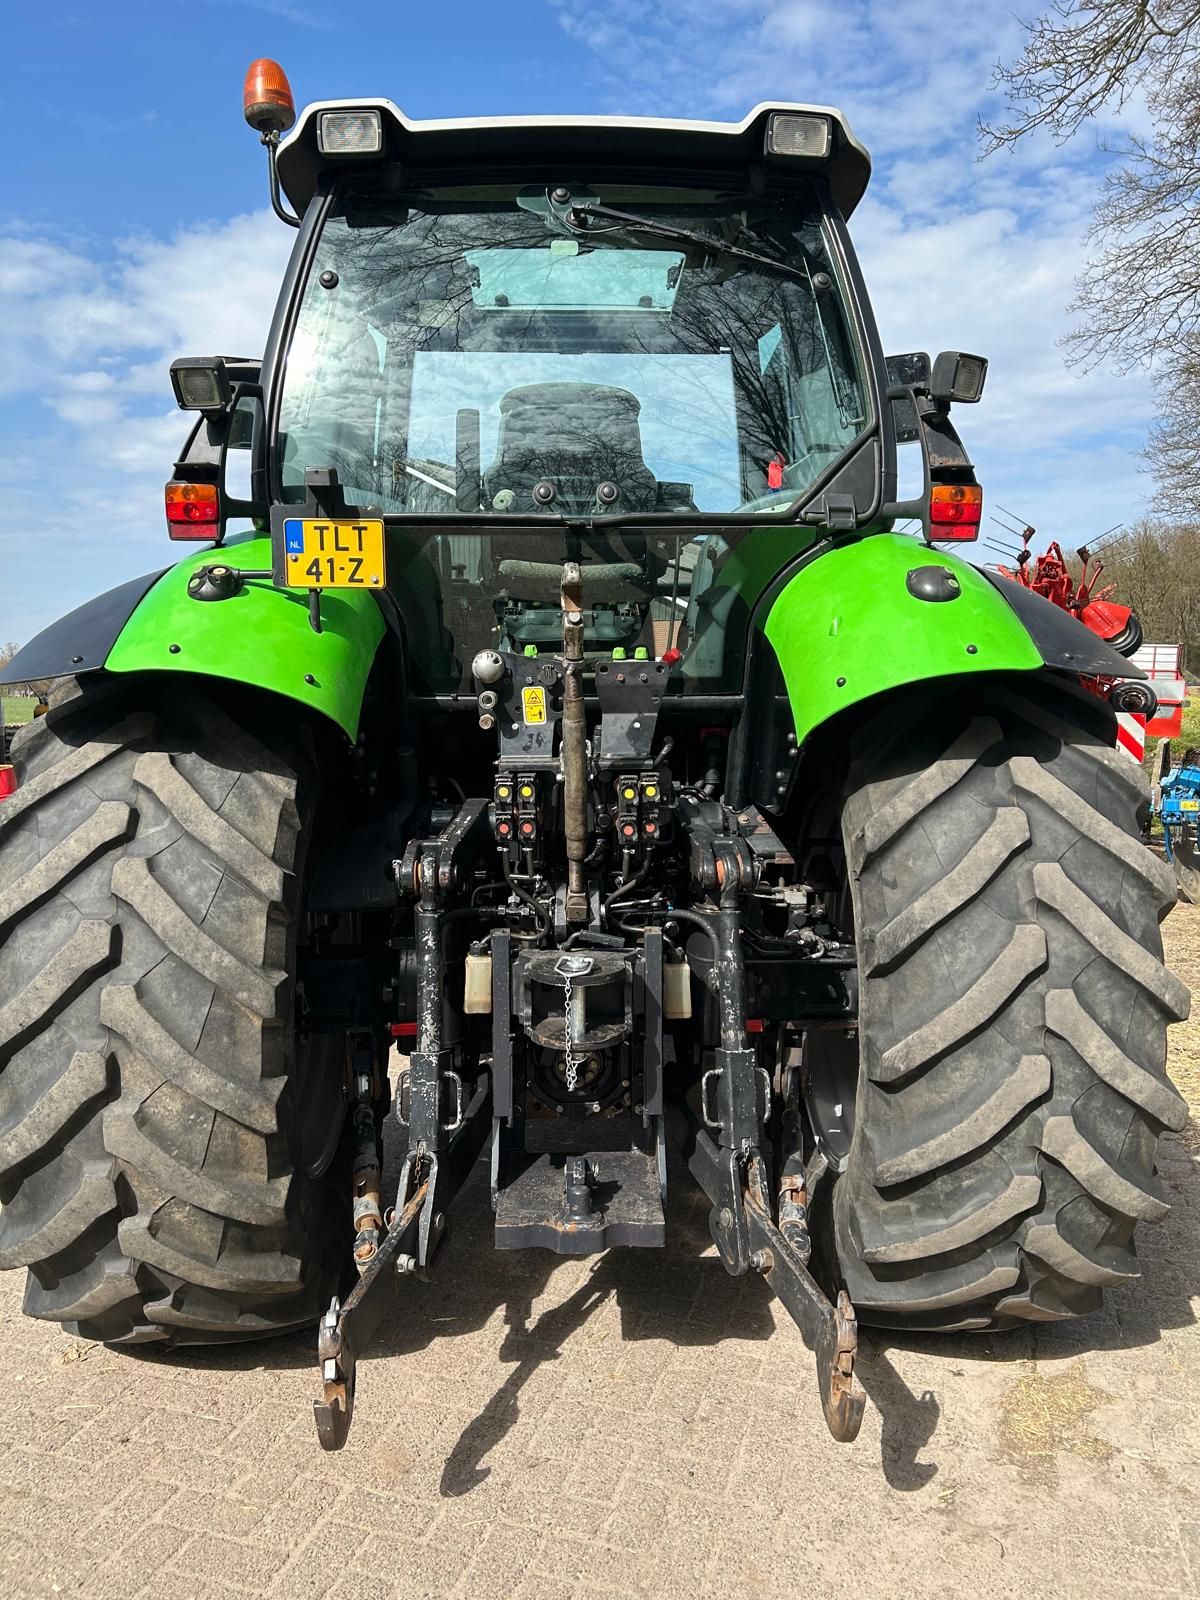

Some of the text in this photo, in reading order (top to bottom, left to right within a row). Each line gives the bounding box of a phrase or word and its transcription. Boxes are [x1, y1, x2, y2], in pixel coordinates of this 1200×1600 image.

[289, 540, 301, 549] NL
[313, 525, 368, 552] TLT
[305, 557, 364, 583] 41-Z
